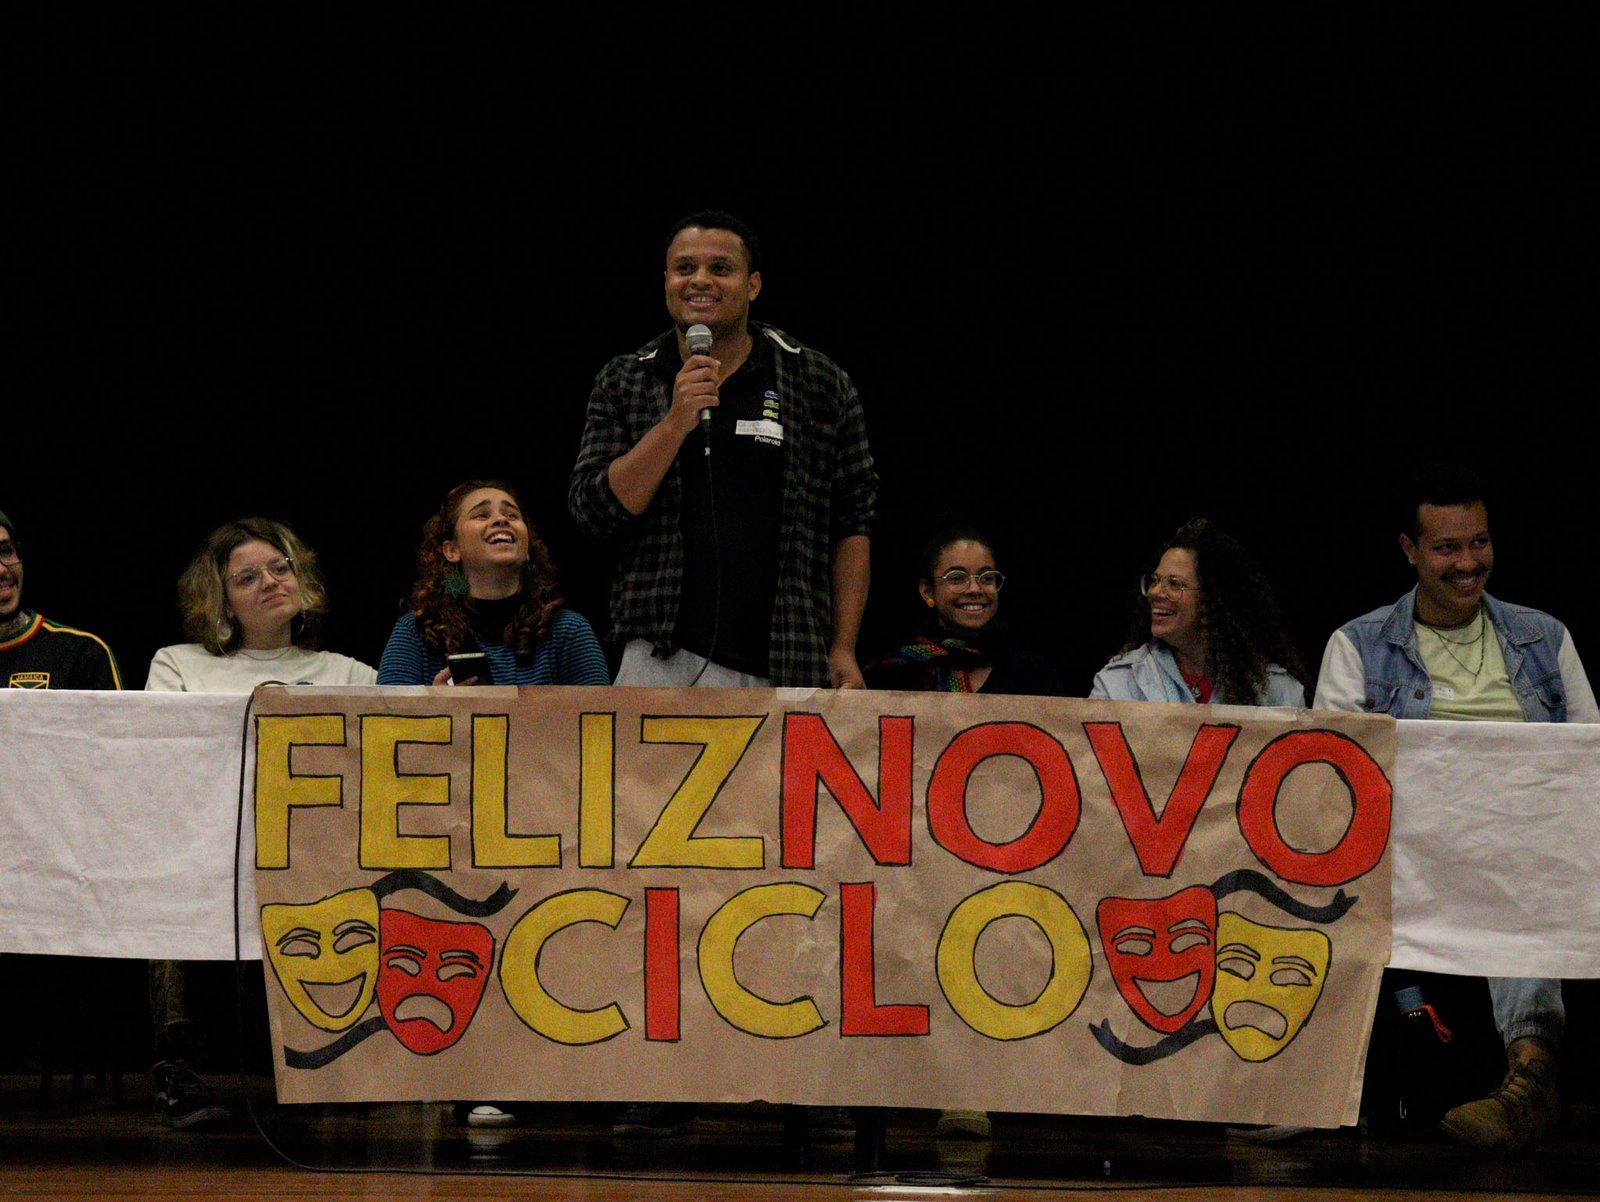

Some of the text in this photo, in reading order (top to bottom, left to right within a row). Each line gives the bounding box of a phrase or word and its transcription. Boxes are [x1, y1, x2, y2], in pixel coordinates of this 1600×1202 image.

[254, 711, 1393, 887] FELIZ NOVO
[498, 880, 1093, 1046] CICLO
